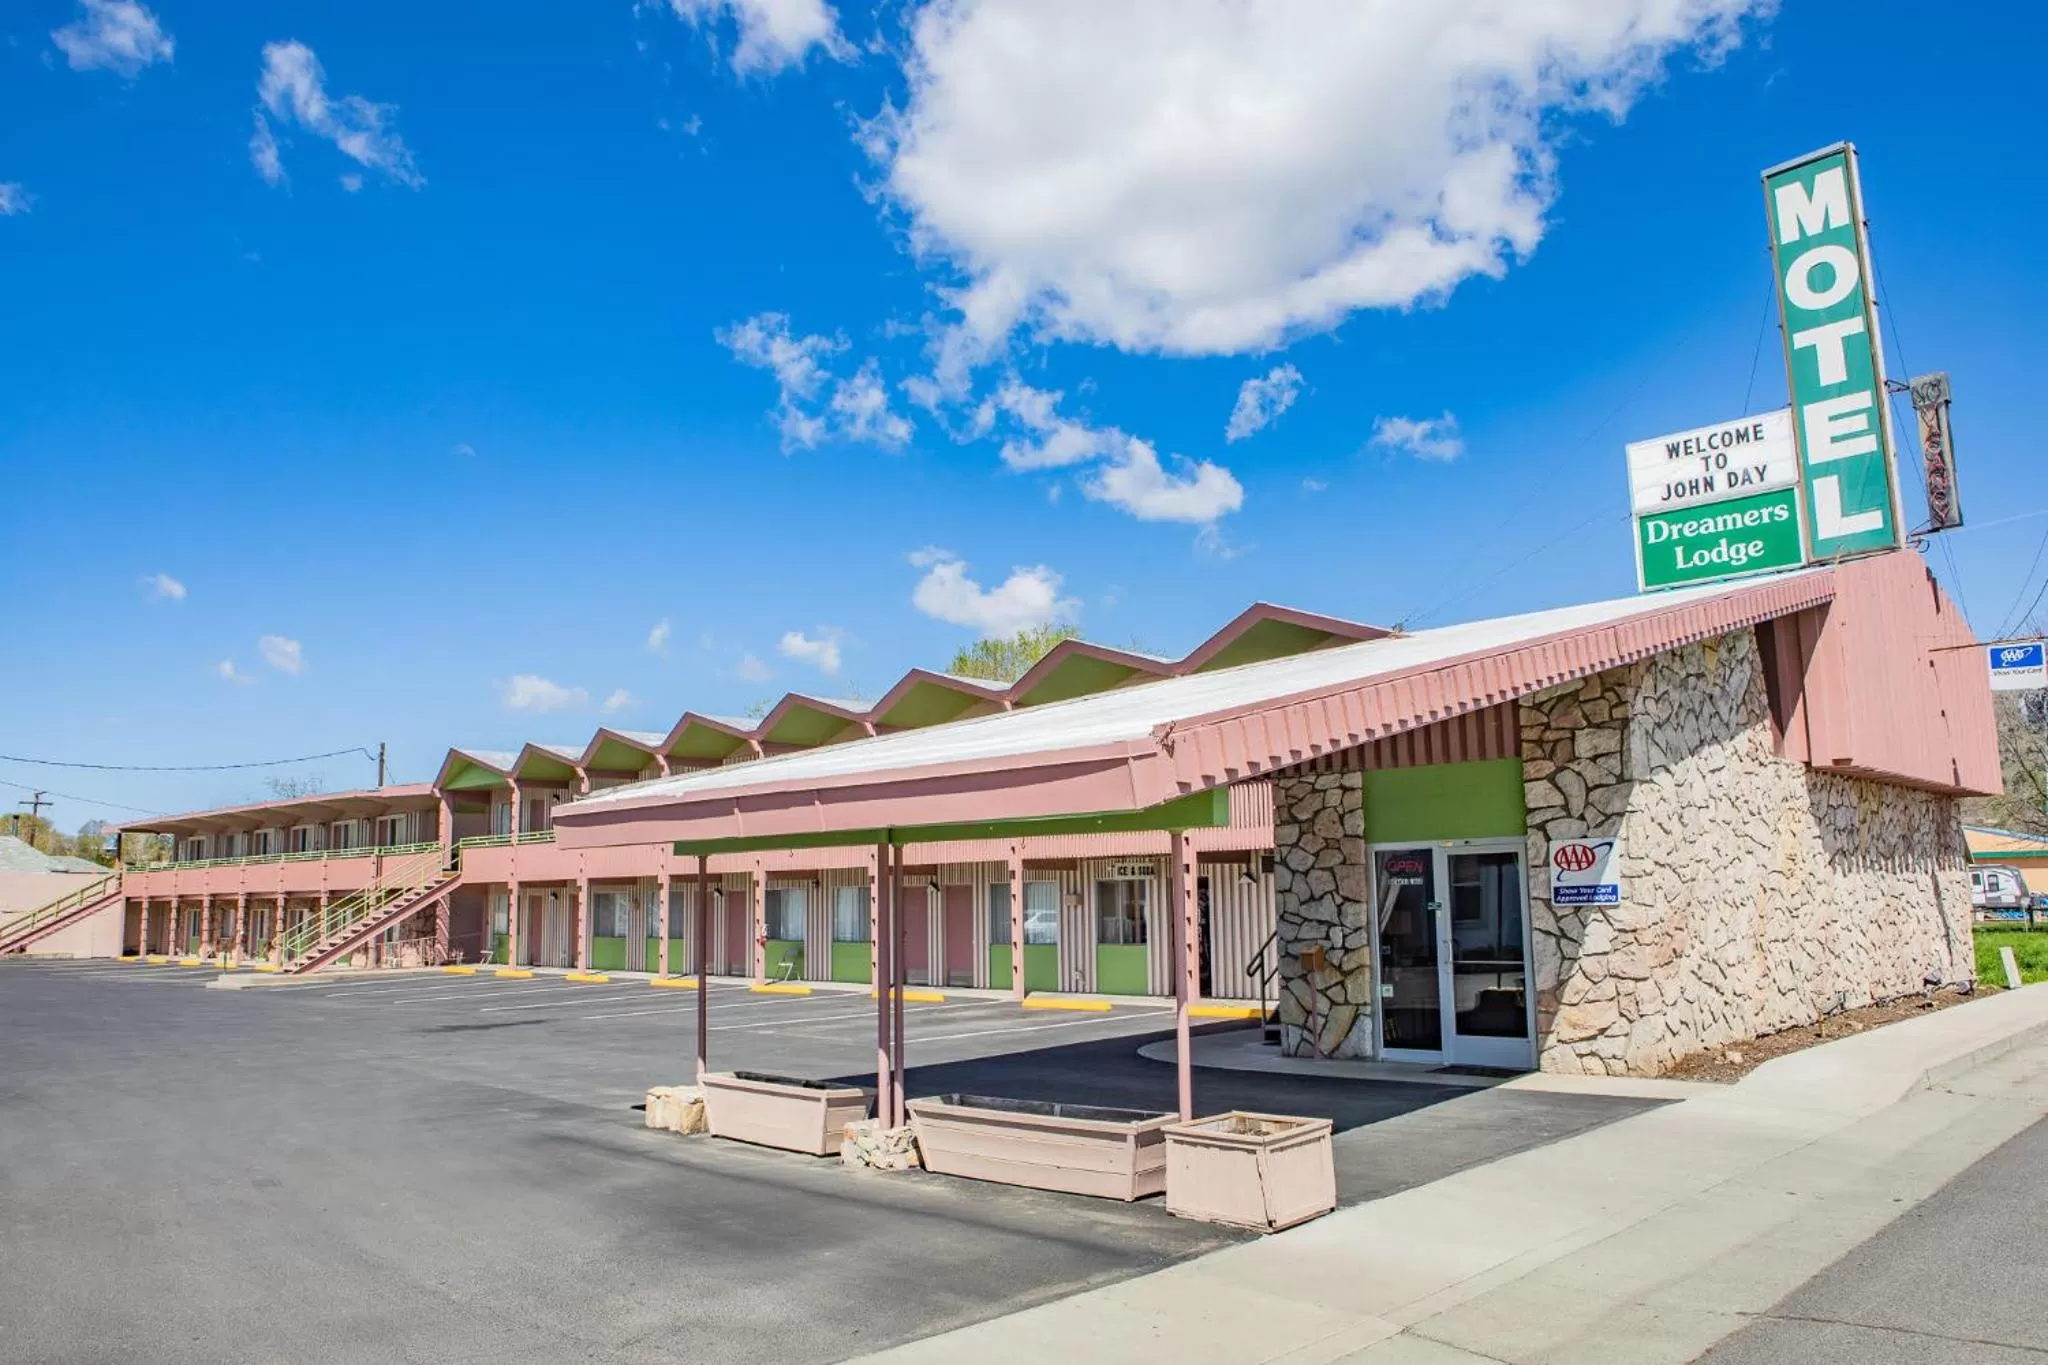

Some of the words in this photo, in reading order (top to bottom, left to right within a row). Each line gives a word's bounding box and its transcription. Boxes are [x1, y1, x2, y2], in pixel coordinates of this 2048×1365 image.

[1774, 166, 1884, 541] MOTEL
[1666, 424, 1764, 459] WELCOME
[1700, 453, 1728, 471] TO
[1661, 475, 1715, 501] JOHN
[1727, 465, 1767, 488] DAY
[1646, 504, 1789, 544] Dreamers
[1674, 538, 1764, 569] Lodge
[2001, 649, 2024, 662] AAA
[1386, 860, 1424, 873] OPEN
[1556, 844, 1594, 871] AAA
[1589, 894, 1617, 902] Lodging
